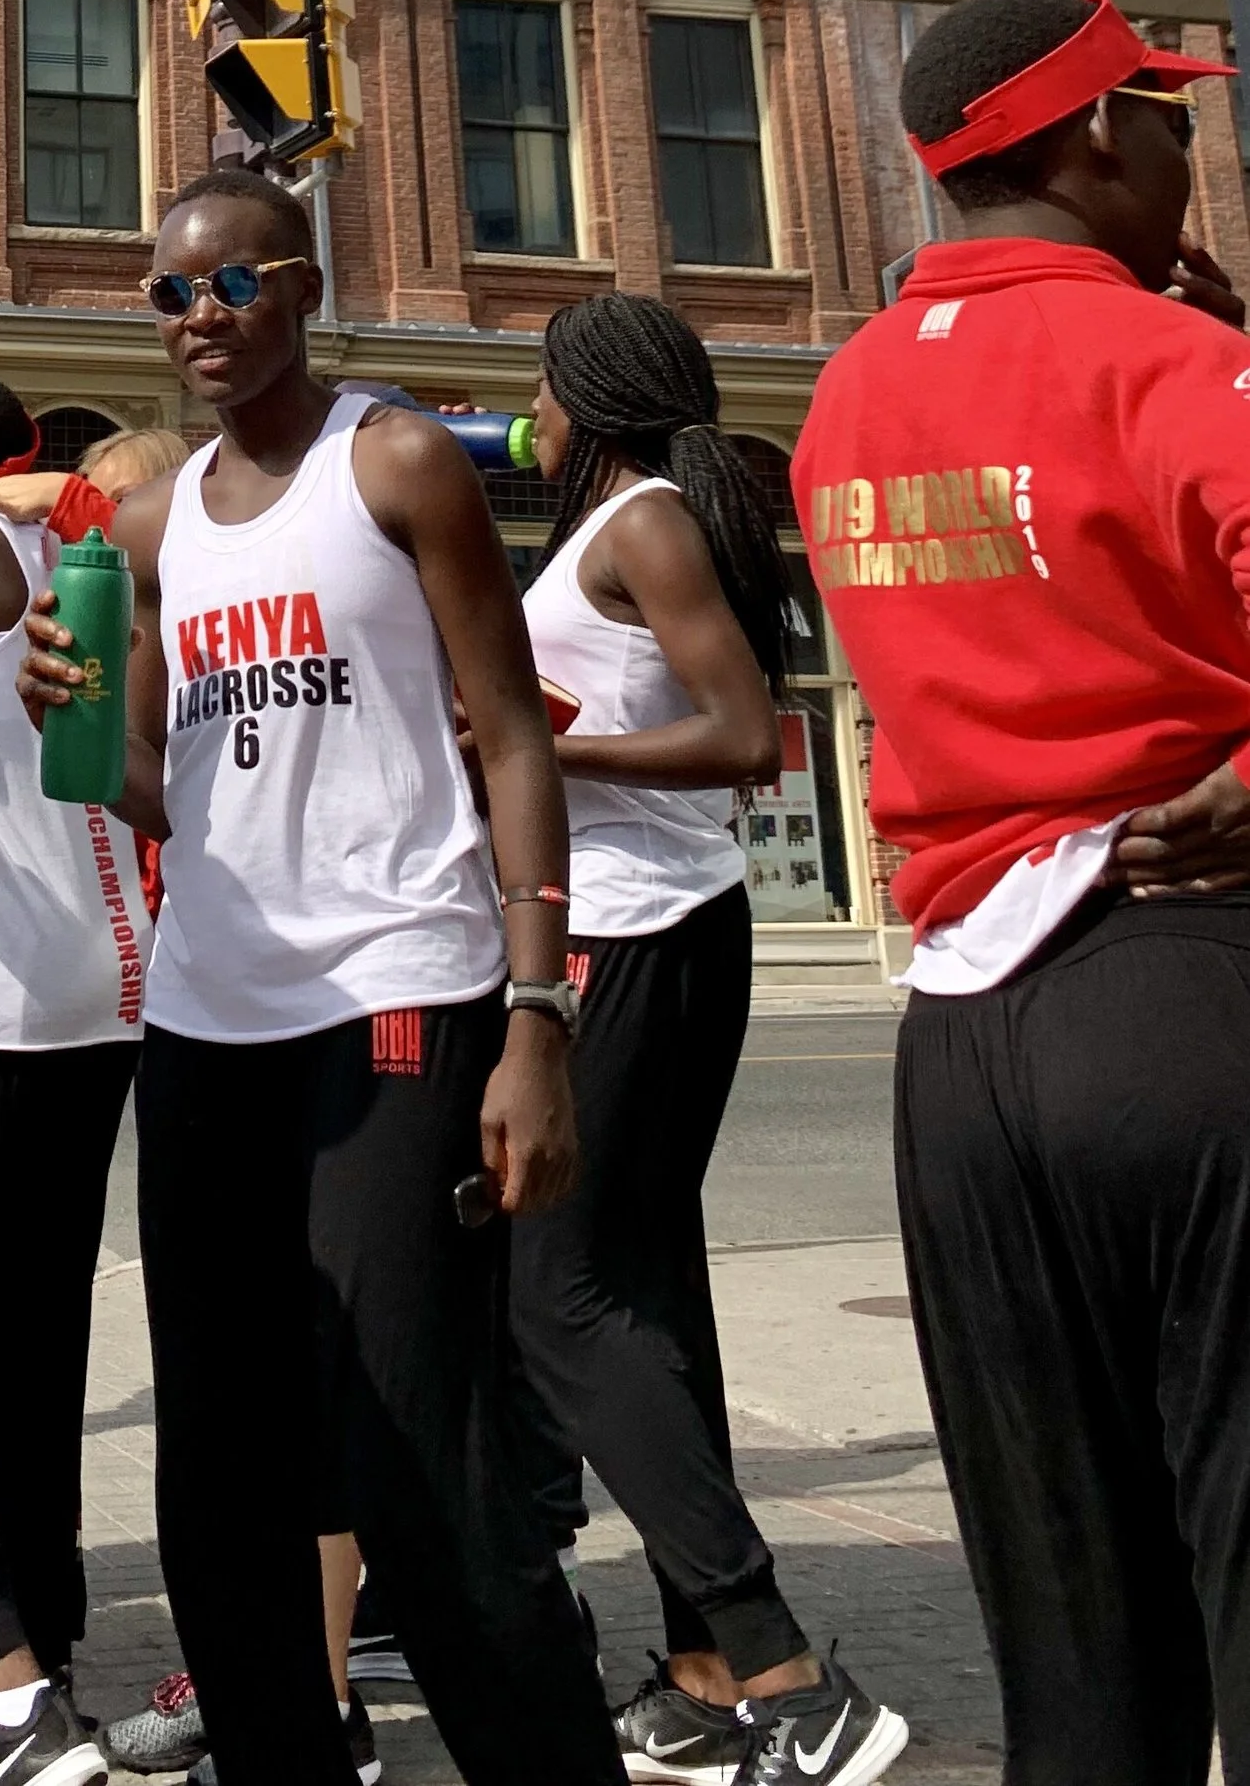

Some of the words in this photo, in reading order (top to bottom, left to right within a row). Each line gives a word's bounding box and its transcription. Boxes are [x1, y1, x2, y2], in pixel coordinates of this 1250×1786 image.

[883, 465, 1014, 536] WORLD
[177, 592, 328, 682] KENYA
[175, 658, 352, 732] LACROSSE
[234, 715, 260, 770] 6
[372, 1062, 421, 1075] SPORTS
